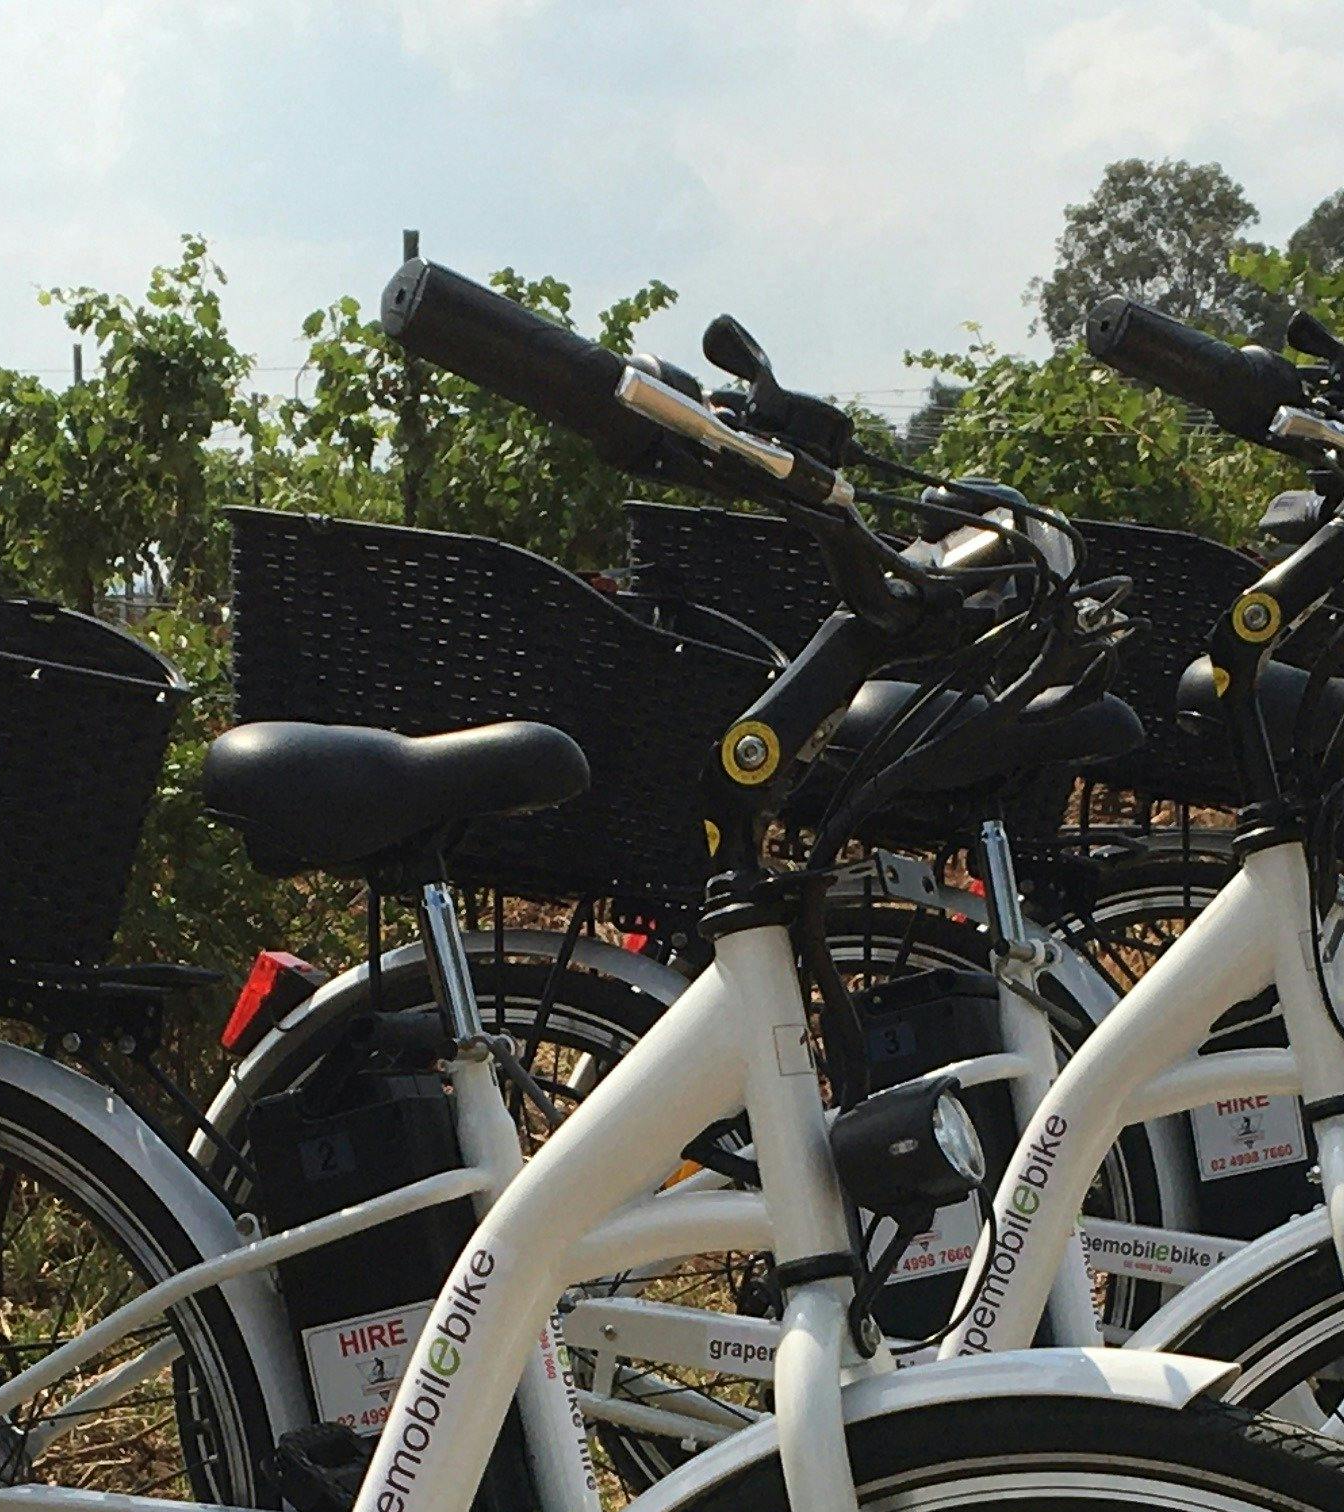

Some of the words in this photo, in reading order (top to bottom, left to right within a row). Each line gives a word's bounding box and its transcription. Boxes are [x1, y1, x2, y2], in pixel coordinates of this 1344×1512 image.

[884, 1029, 900, 1055] 3
[1216, 1095, 1271, 1116] HIRE
[318, 1142, 338, 1171] 2
[338, 1319, 408, 1357] HIRE
[361, 1405, 392, 1426] 499
